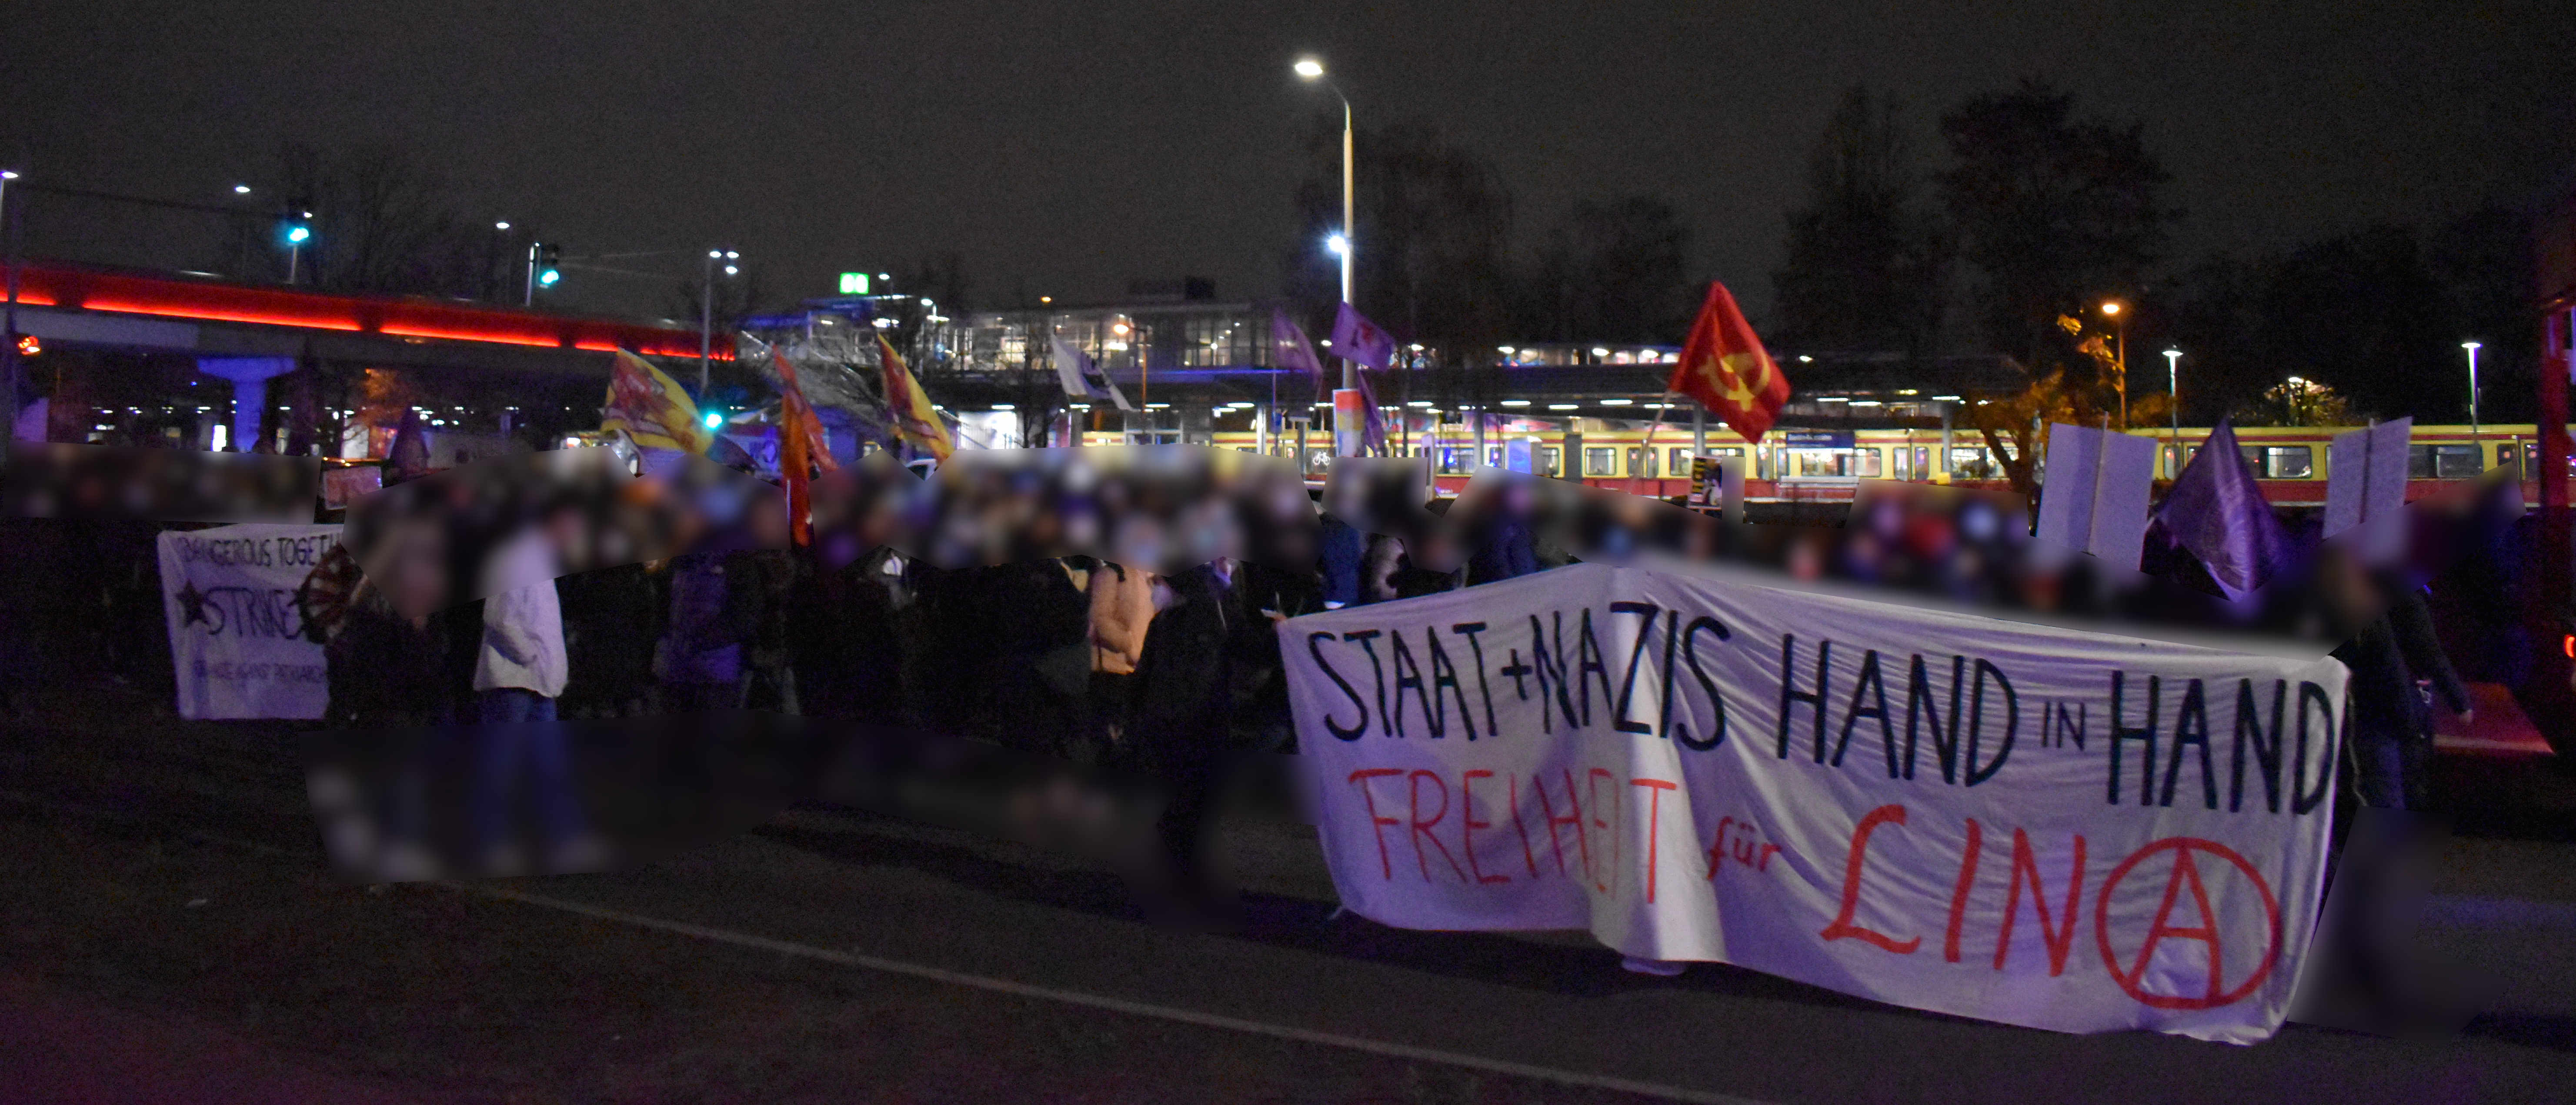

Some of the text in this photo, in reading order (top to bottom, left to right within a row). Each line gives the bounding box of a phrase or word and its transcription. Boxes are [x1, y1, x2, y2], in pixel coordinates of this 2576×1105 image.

[1777, 633, 2019, 787] HAND
[2042, 701, 2086, 751] IN
[2107, 670, 2336, 815] HAND
[1348, 768, 1677, 904] FREIHEIT
[1706, 815, 1782, 881] für
